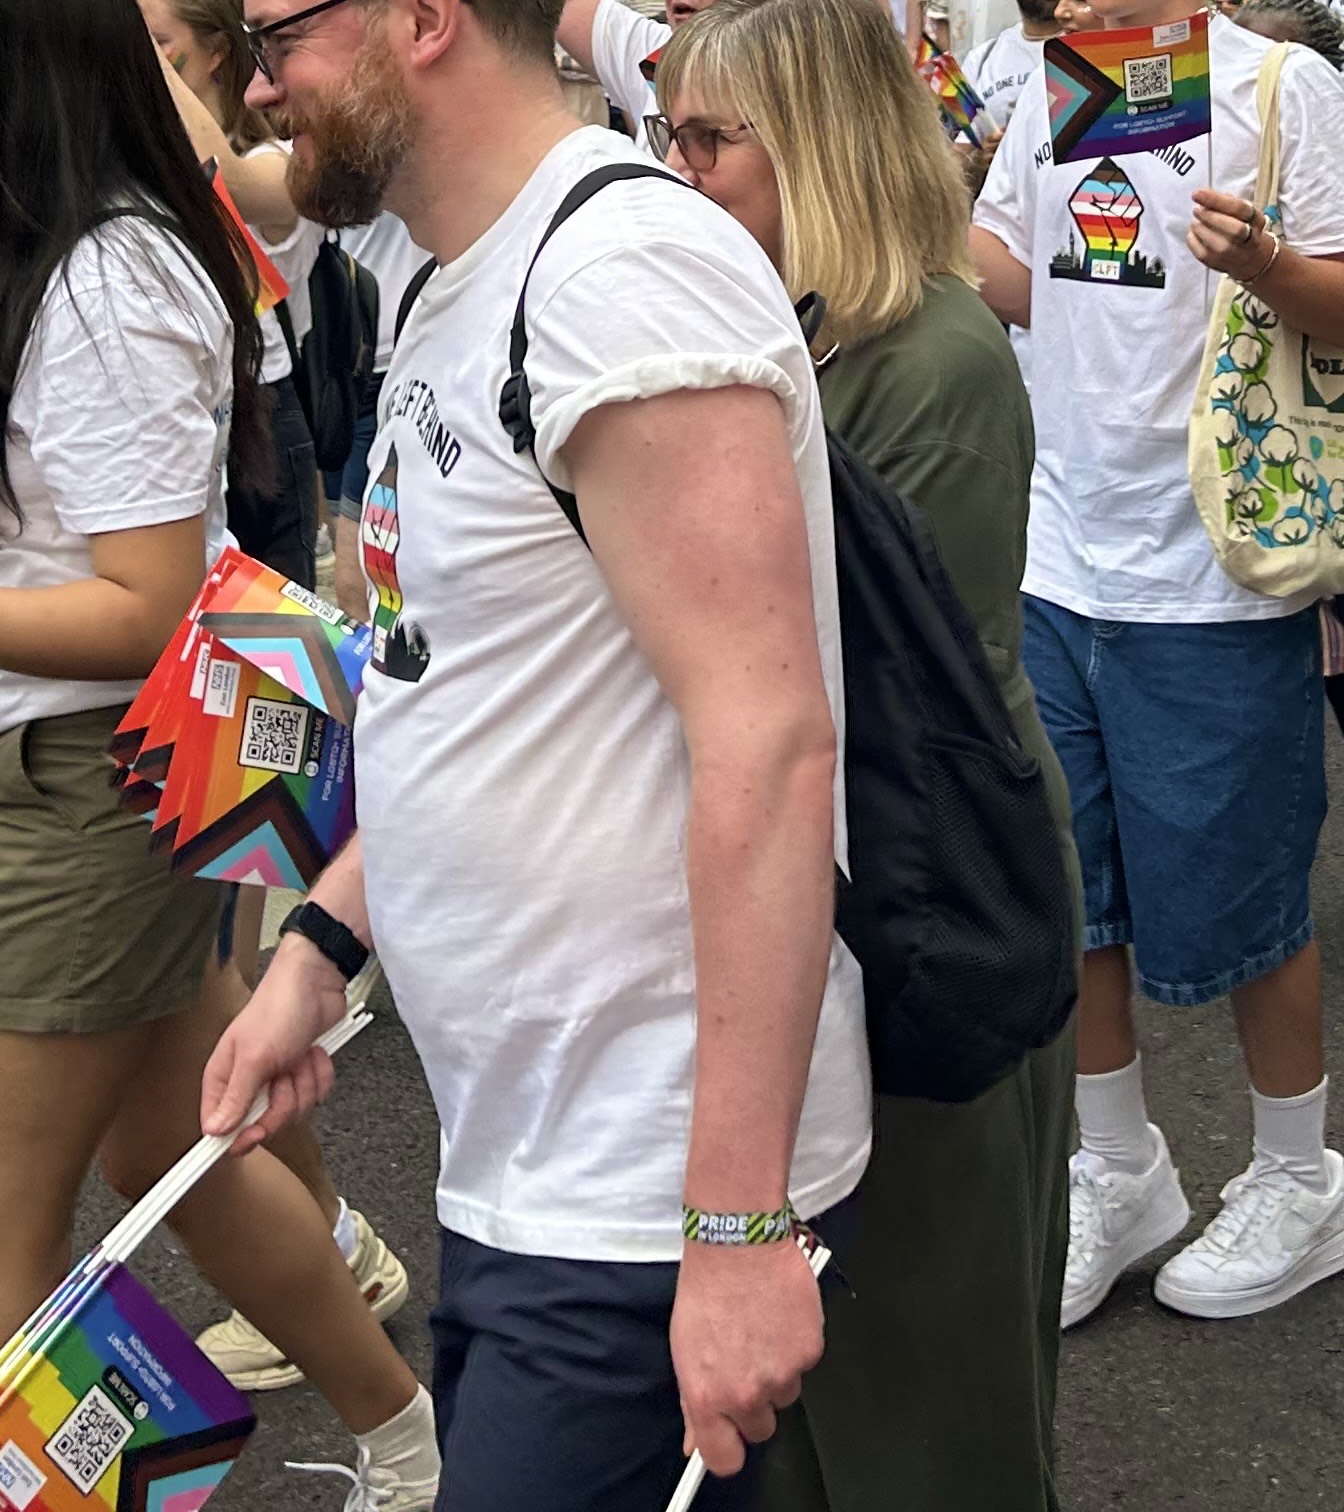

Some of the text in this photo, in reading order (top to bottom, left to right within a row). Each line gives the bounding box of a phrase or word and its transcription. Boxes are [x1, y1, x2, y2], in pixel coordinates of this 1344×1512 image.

[982, 86, 994, 101] NO
[995, 75, 1014, 92] ONE
[1034, 141, 1196, 177] NO IND
[416, 389, 462, 478] BEHIND
[310, 733, 320, 759] SCAN
[322, 780, 333, 801] FOR
[698, 1214, 748, 1232] PRIDE
[708, 1232, 747, 1242] LONDON
